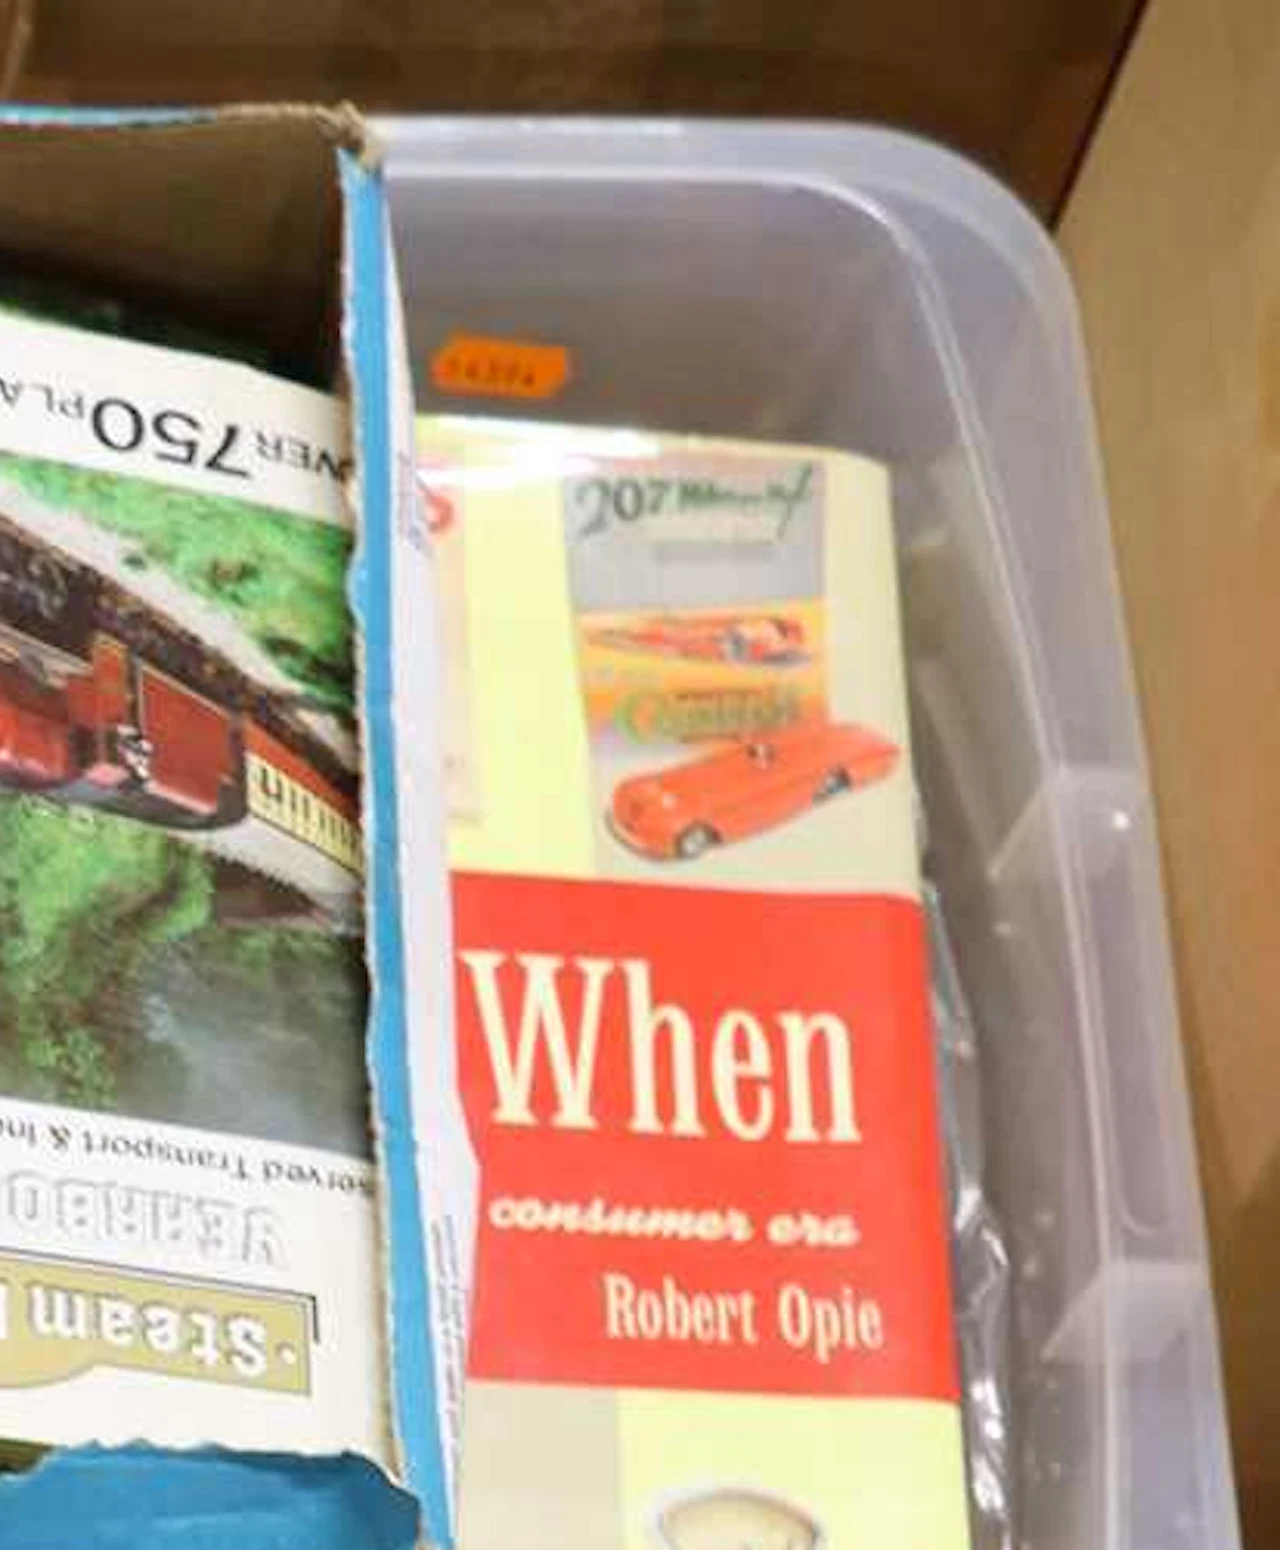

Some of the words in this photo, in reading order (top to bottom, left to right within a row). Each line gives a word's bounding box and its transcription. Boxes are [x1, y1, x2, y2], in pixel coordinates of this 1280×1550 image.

[90, 396, 258, 477] 750
[255, 436, 354, 484] VER
[457, 949, 863, 1145] When
[43, 1122, 73, 1153] &
[75, 1128, 252, 1185] Transport
[487, 1194, 755, 1245] consumer
[765, 1211, 861, 1248] era
[30, 1282, 271, 1378] Steam
[602, 1273, 760, 1345] Robert
[777, 1283, 885, 1364] Opie
